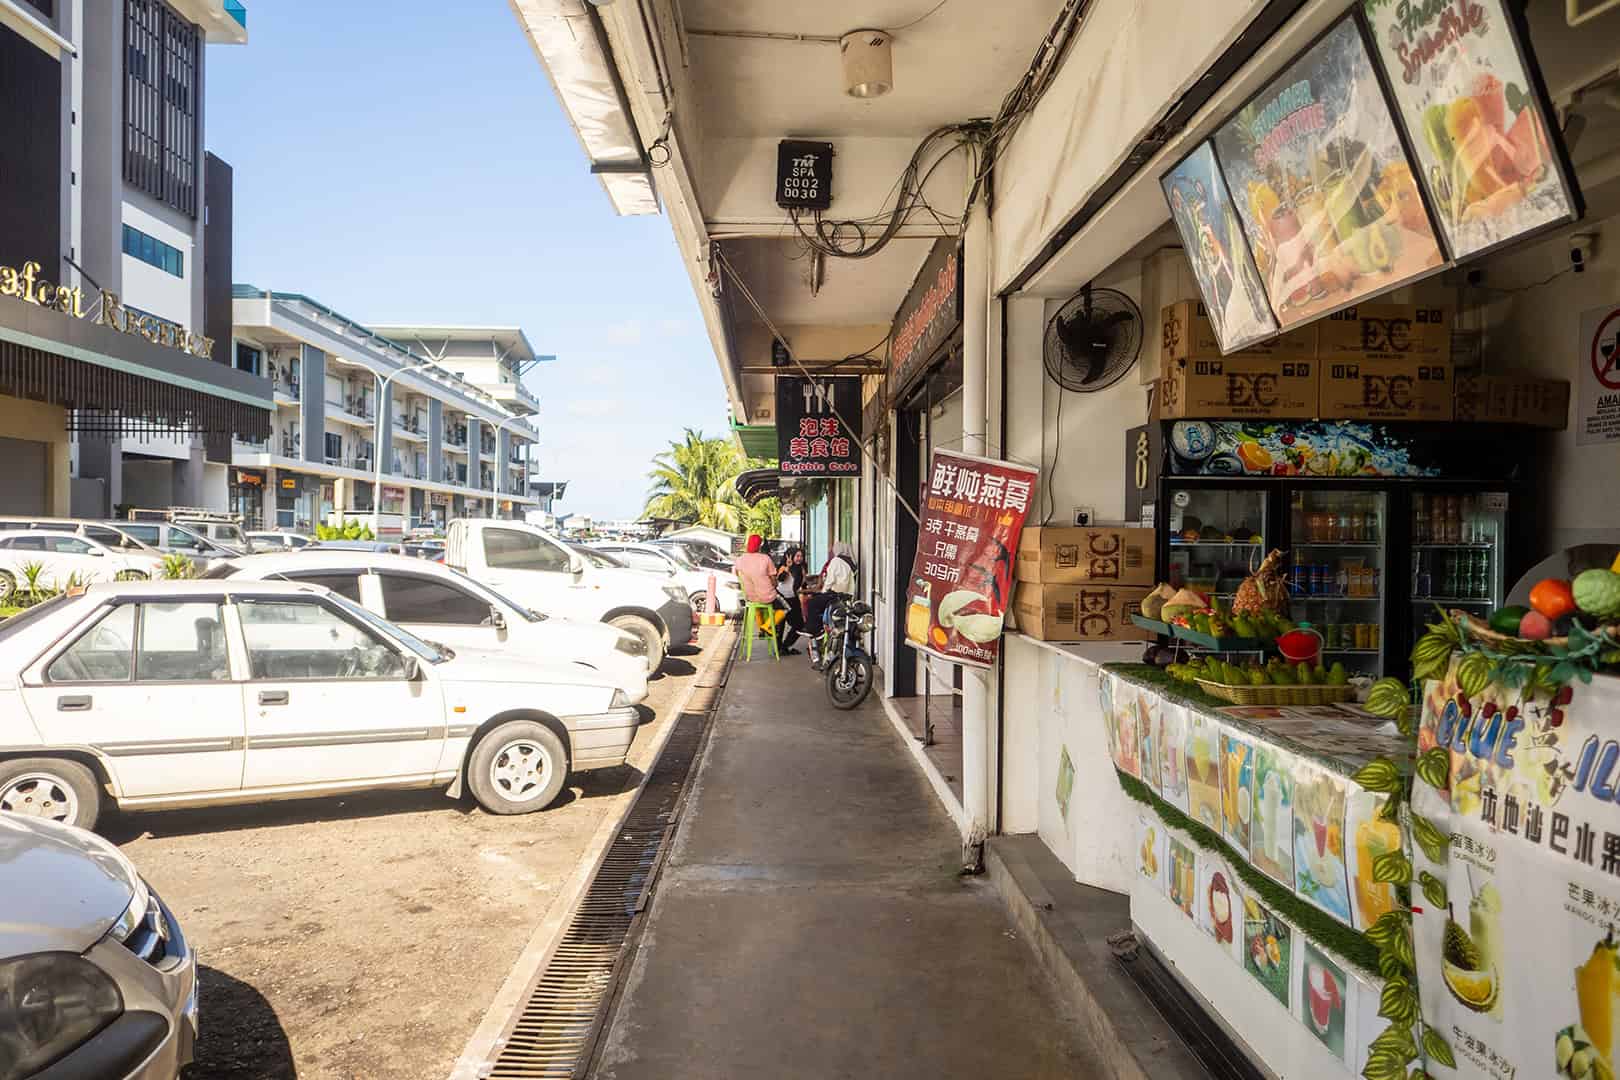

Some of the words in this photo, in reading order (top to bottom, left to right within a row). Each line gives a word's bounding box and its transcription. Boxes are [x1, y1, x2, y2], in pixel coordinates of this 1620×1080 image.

[792, 155, 818, 167] TM
[792, 168, 815, 177] SPA
[1226, 372, 1279, 407] EC
[1597, 394, 1620, 411] AMA
[799, 418, 839, 437] 泡沫
[790, 438, 850, 457] 美食馆
[782, 461, 825, 474] Bubble
[931, 463, 1031, 513] 鲜炖燕窝
[934, 541, 958, 561] 只需
[924, 562, 960, 584] 30马币
[1436, 698, 1525, 769] BLUE
